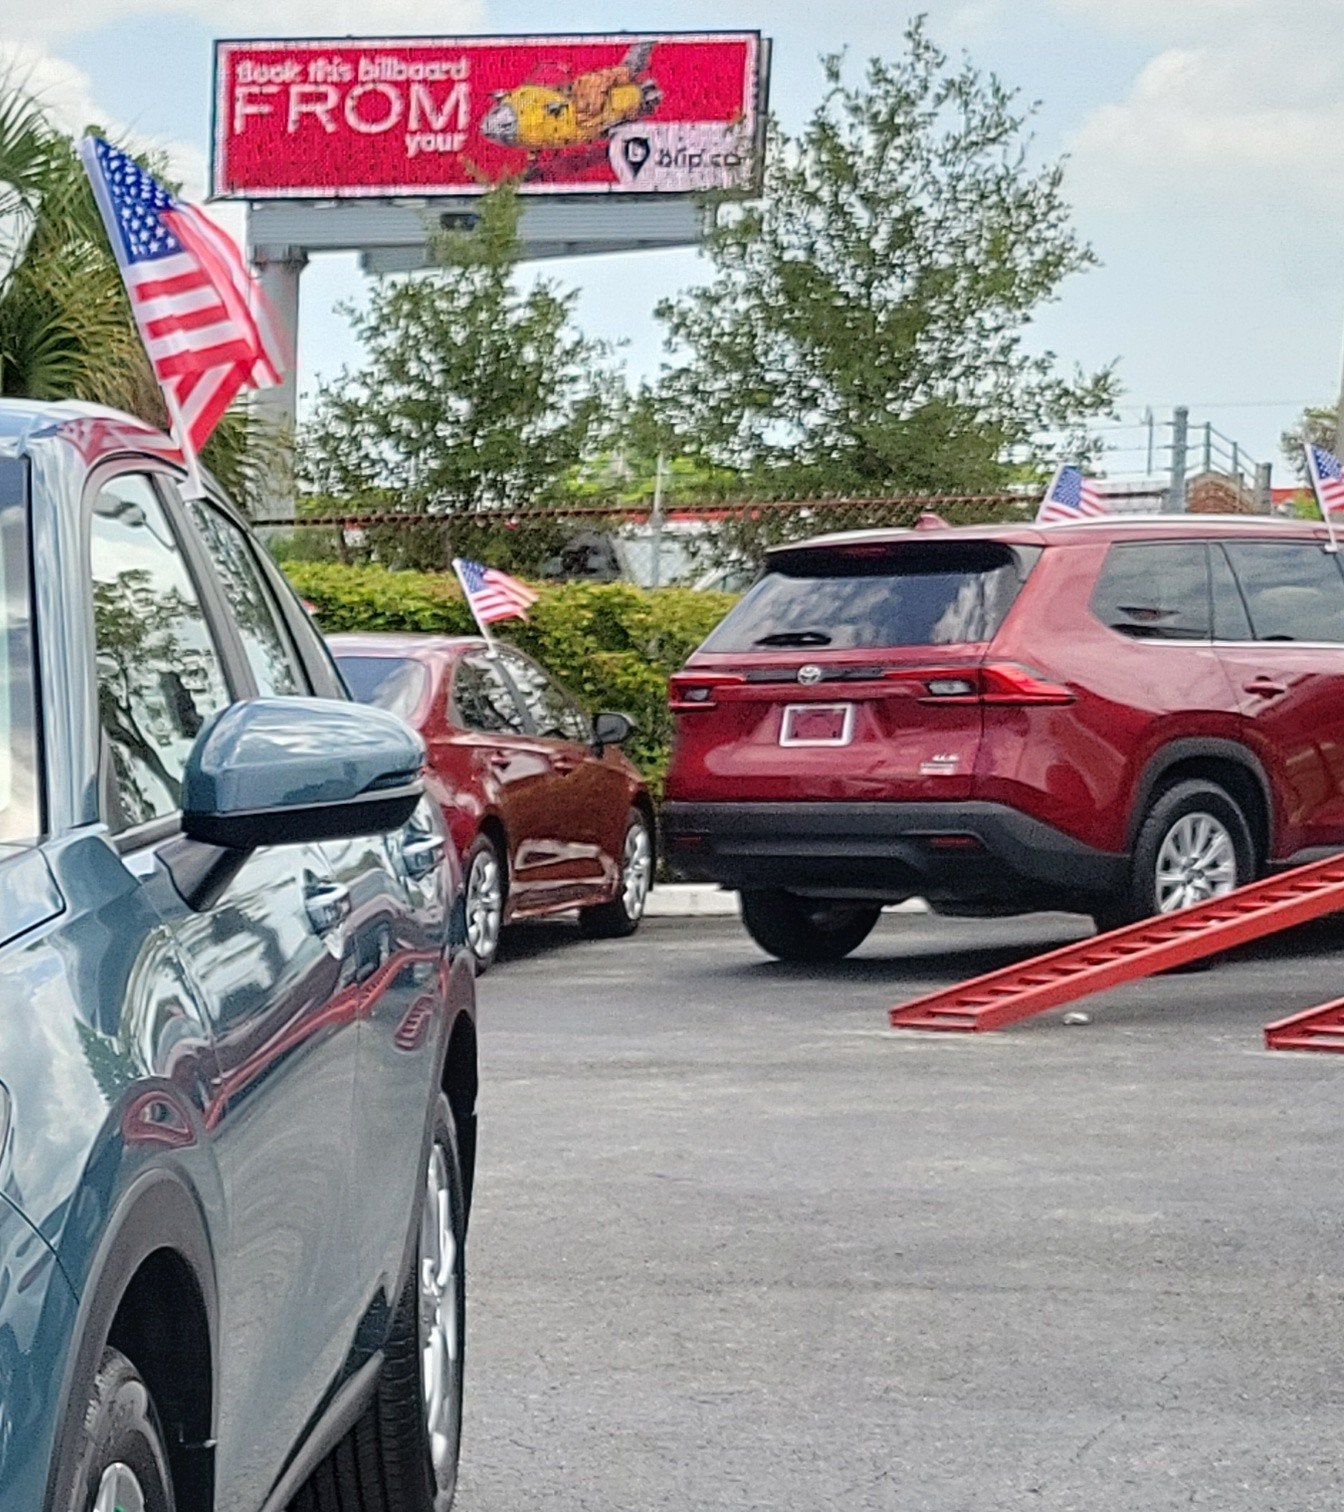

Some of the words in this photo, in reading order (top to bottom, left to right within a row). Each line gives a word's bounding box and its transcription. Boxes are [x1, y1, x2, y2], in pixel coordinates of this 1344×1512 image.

[308, 56, 355, 83] this
[358, 54, 471, 82] billboard
[234, 82, 470, 135] FROM
[406, 132, 468, 158] your
